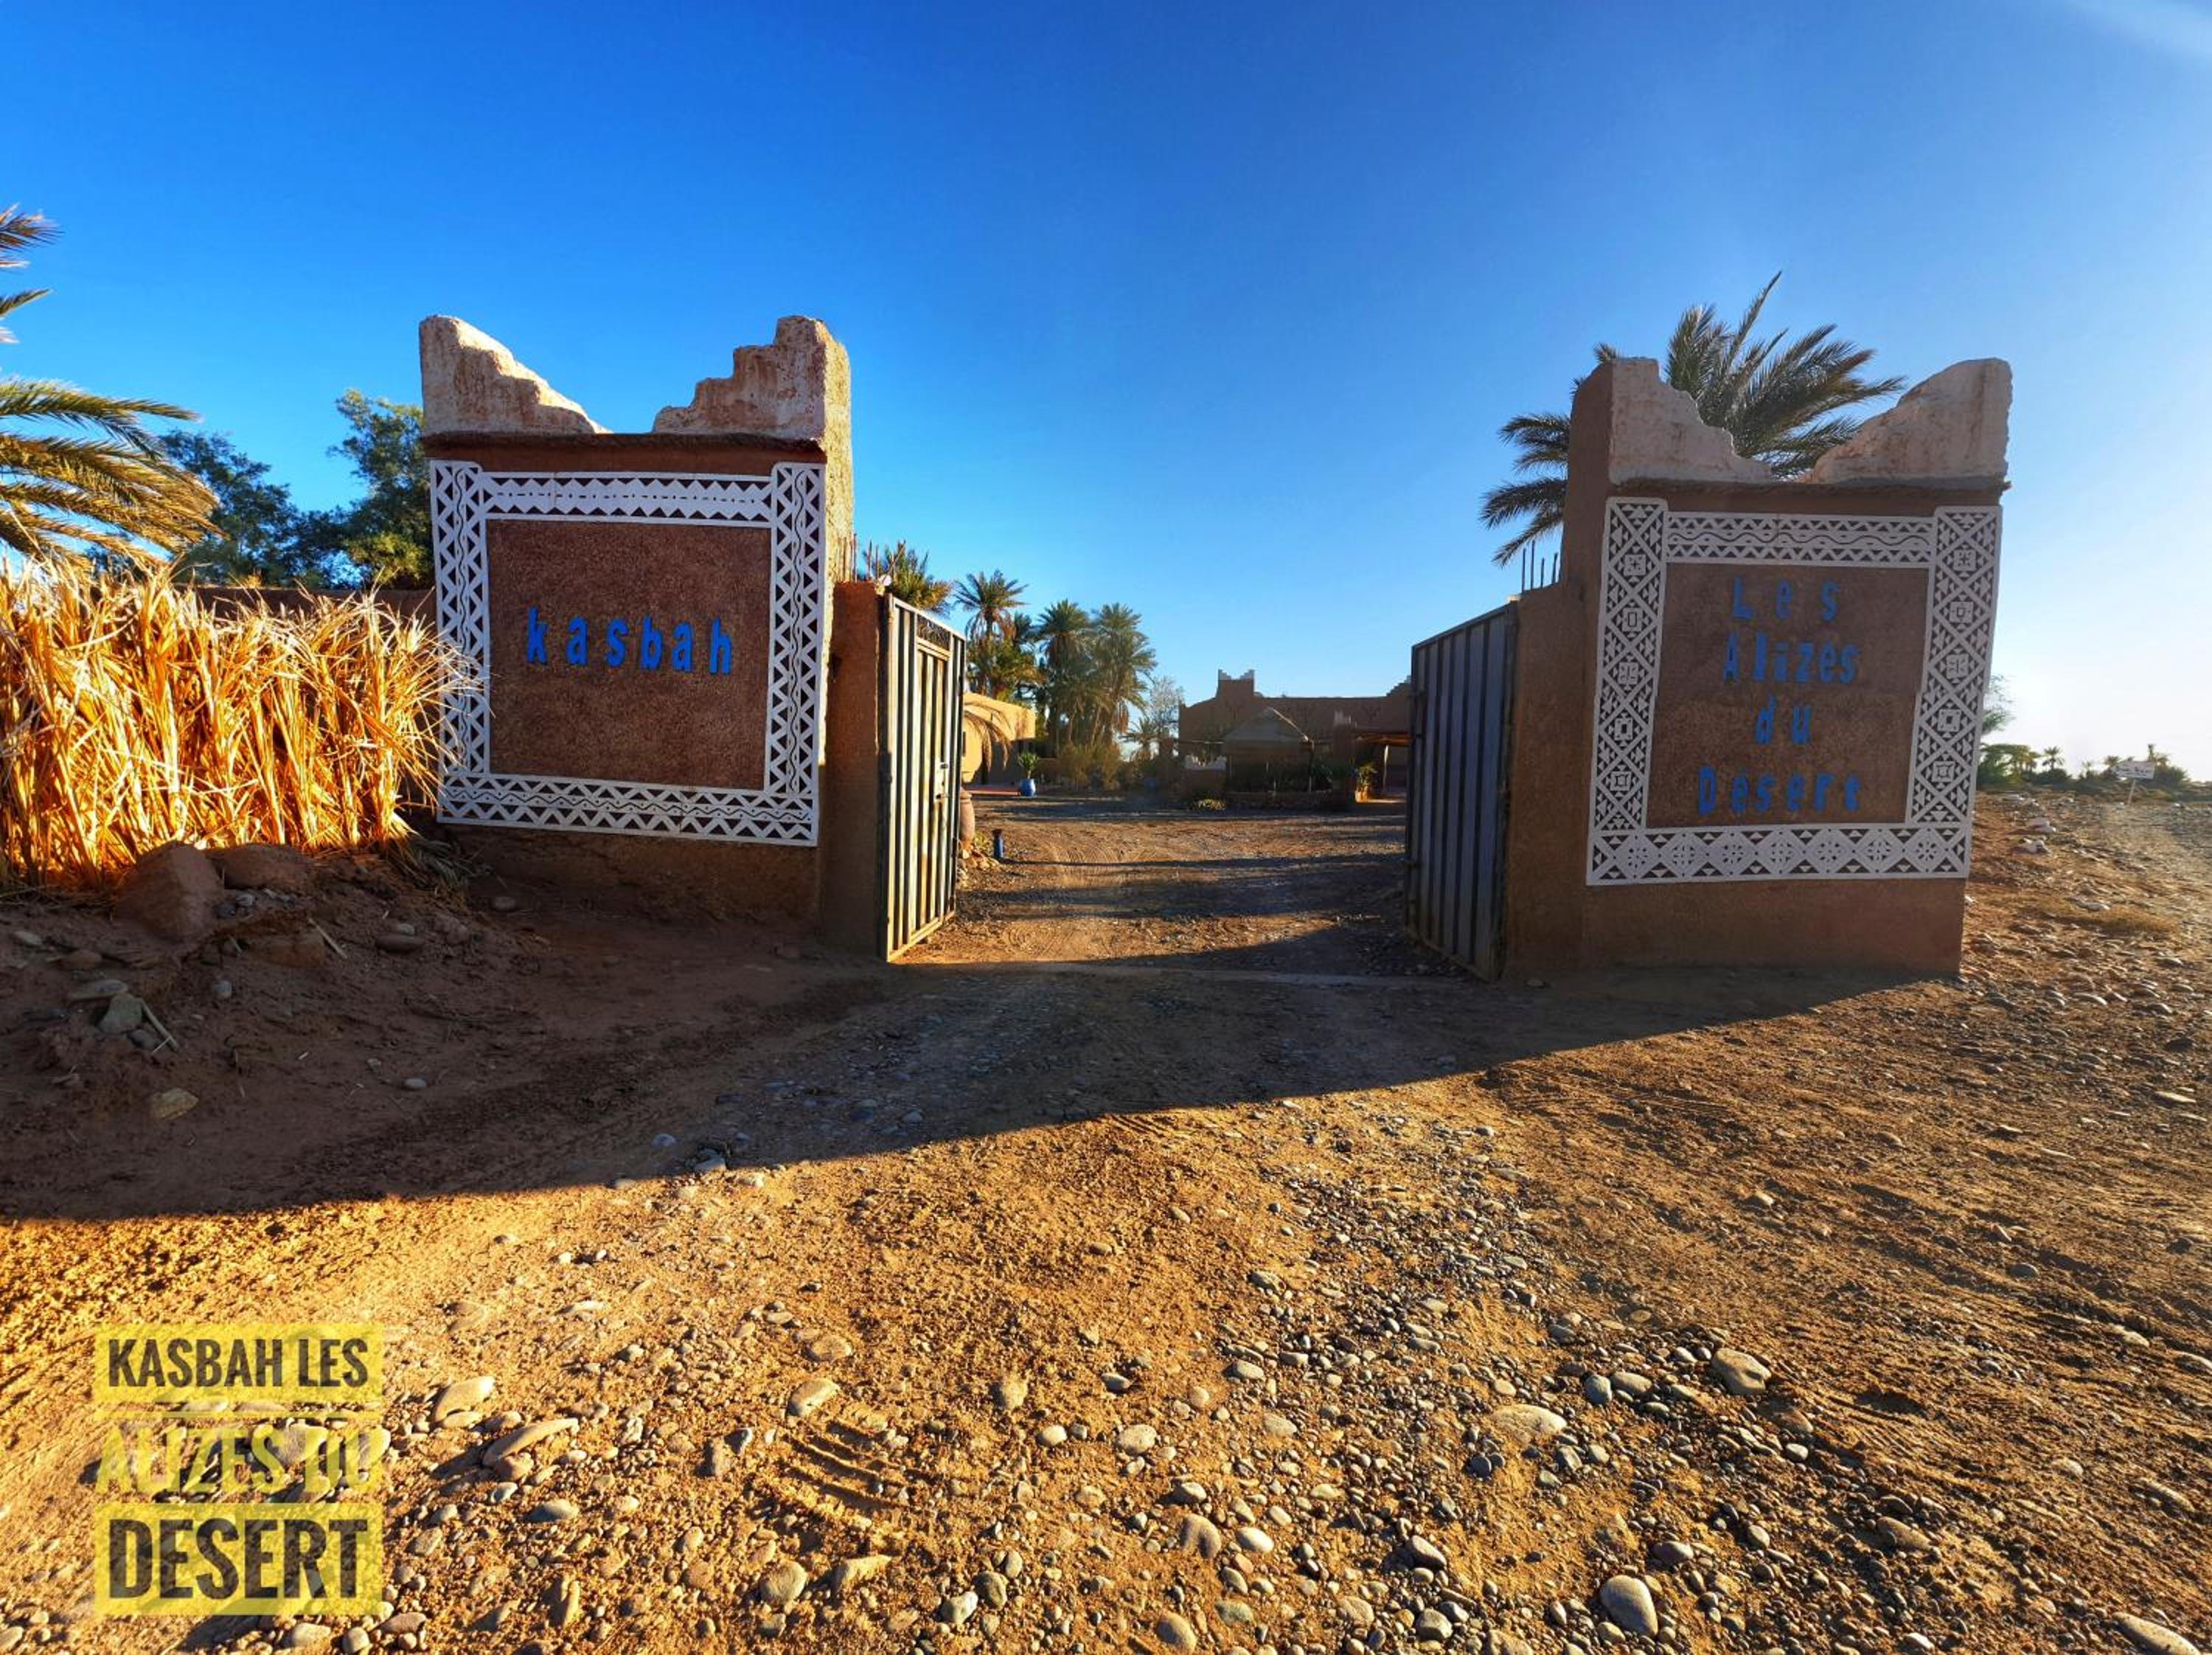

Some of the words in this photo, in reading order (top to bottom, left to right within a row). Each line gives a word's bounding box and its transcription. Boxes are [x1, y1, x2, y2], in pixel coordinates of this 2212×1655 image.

[1733, 575, 1840, 621] Les
[527, 606, 733, 675] kasbah
[1753, 691, 1813, 745] du
